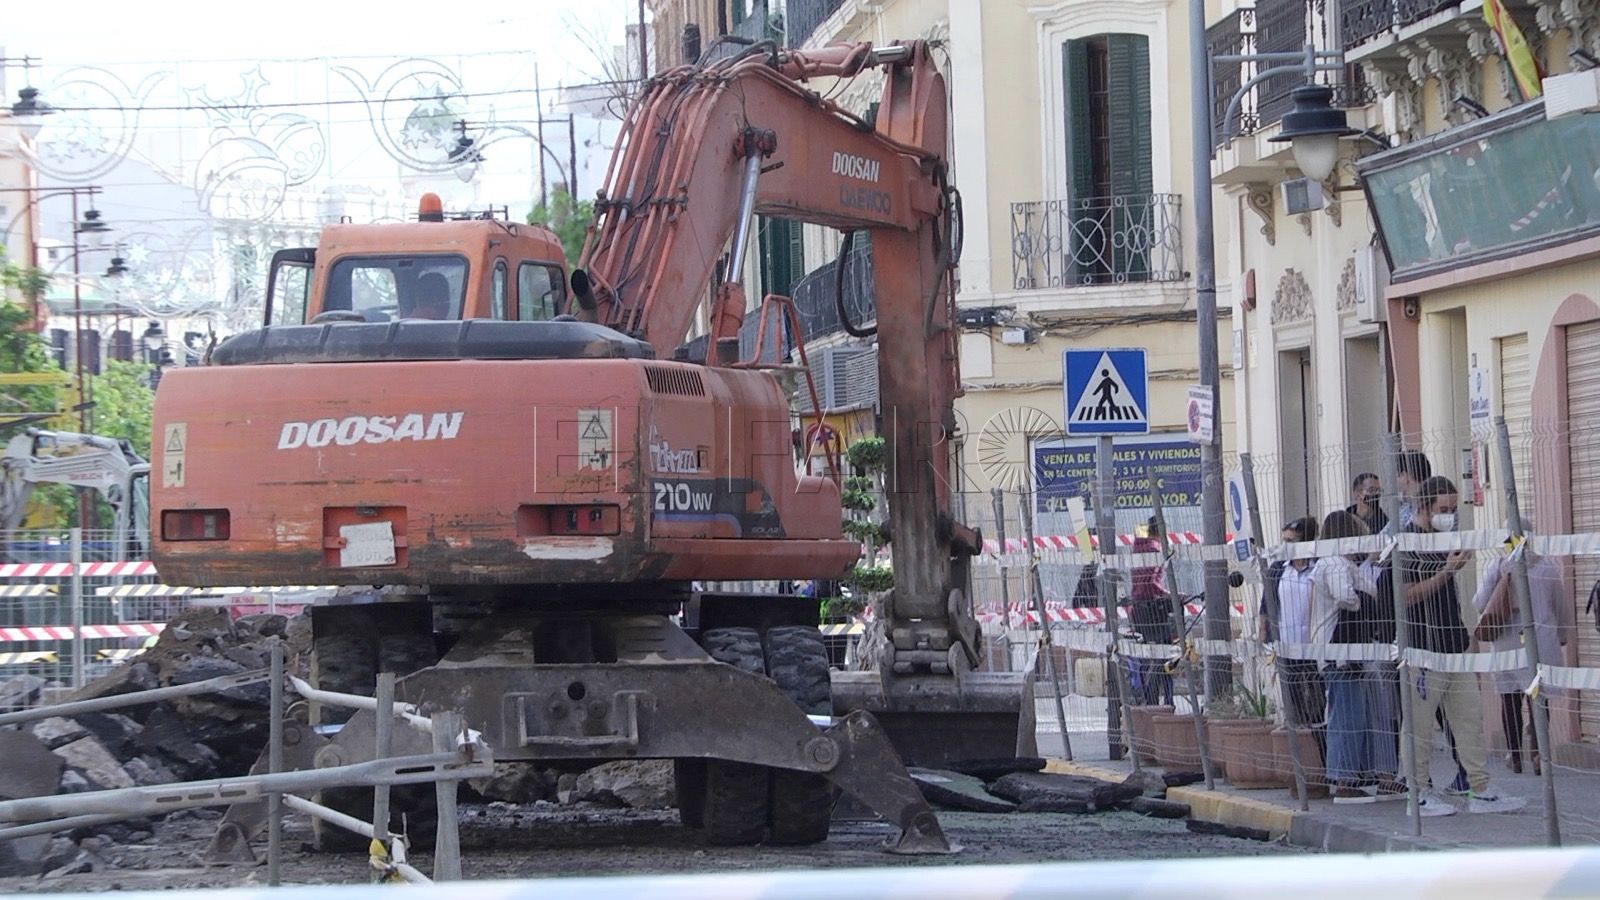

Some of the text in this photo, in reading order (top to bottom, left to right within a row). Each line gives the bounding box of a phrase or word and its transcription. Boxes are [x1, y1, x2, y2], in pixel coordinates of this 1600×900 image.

[832, 152, 880, 183] DOOSAN
[277, 411, 464, 450] DOOSAN
[1043, 447, 1201, 465] VENTA DE LALES Y VIVIENDAS
[1123, 466, 1129, 475] 3
[1130, 466, 1137, 475] Y
[1138, 466, 1144, 474] 4
[654, 482, 713, 511] 210 WV
